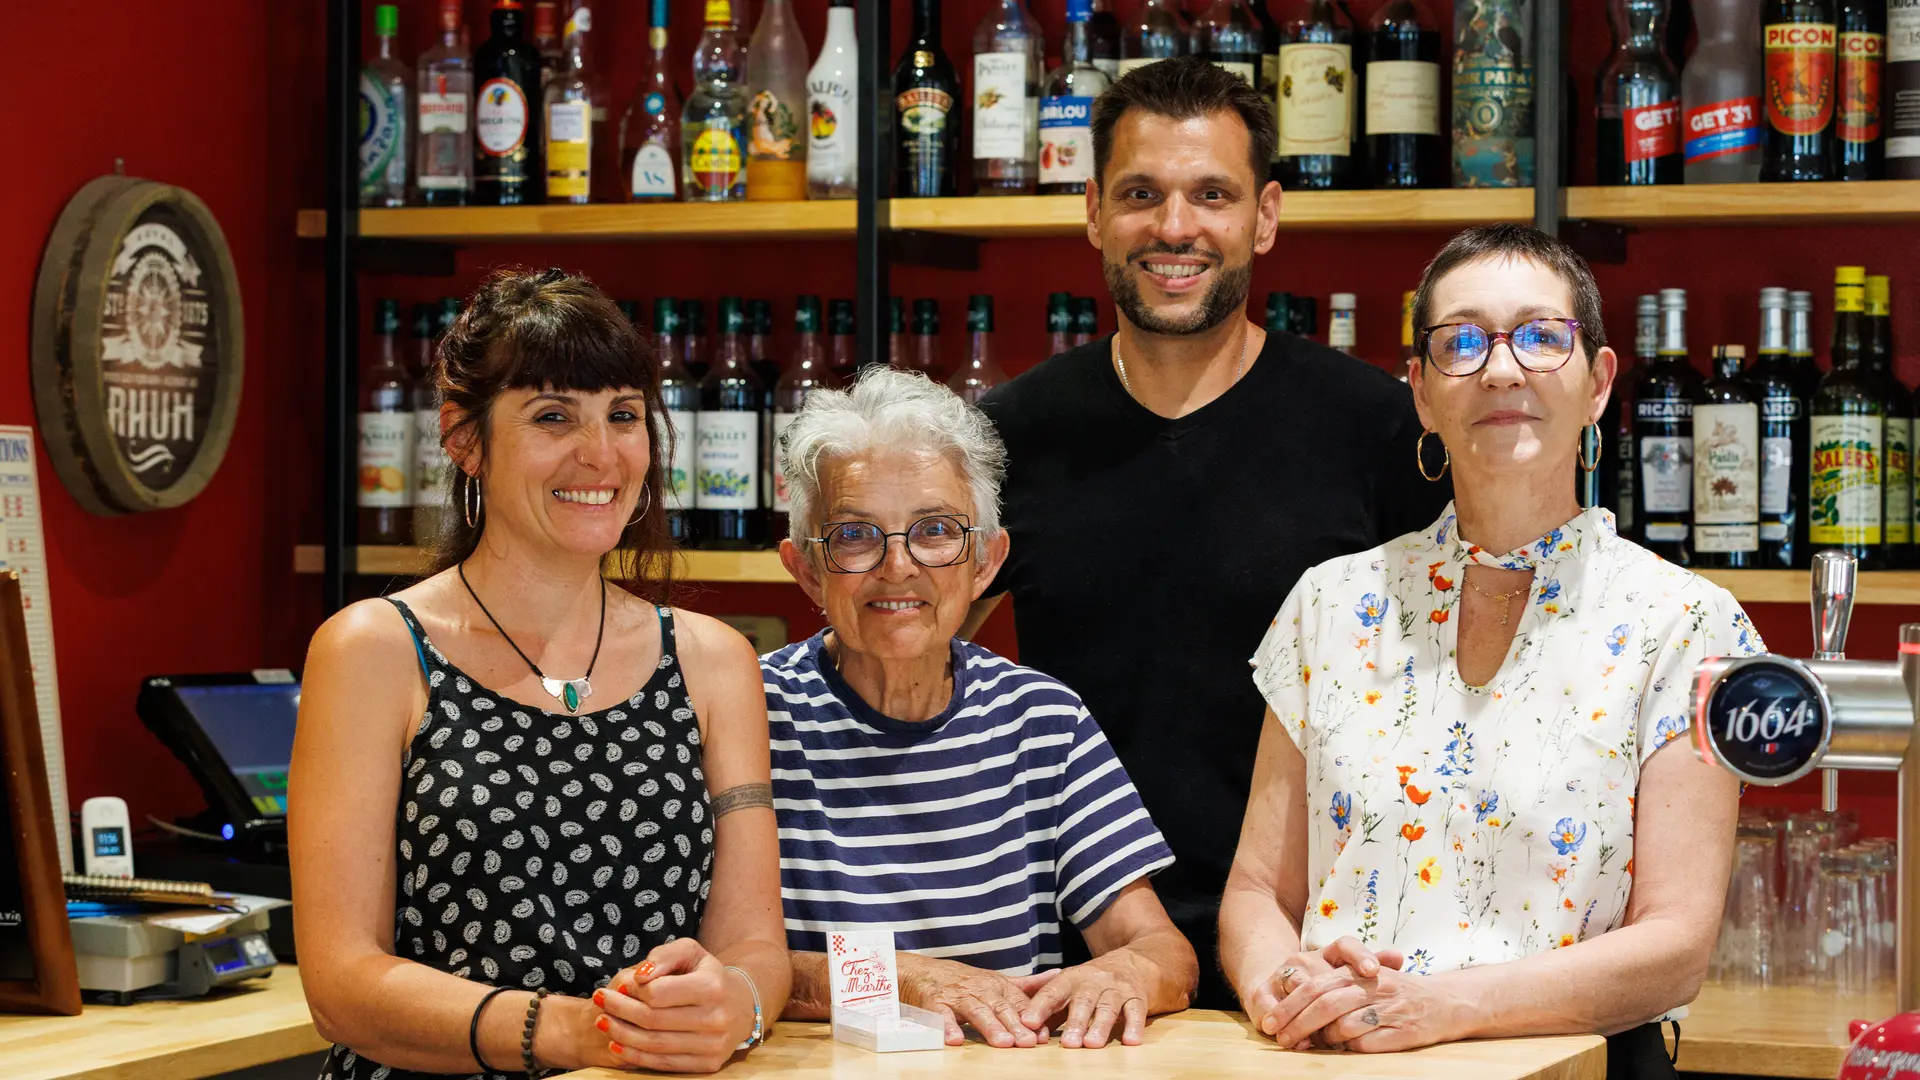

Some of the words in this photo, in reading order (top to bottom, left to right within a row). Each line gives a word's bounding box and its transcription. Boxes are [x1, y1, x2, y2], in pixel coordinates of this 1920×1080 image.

[1768, 29, 1833, 45] PICON
[1842, 38, 1878, 53] ICO
[1634, 108, 1674, 131] GET
[1690, 108, 1729, 132] GET
[1730, 104, 1753, 124] 31
[1763, 403, 1796, 415] ARD
[1814, 449, 1874, 473] SALERS
[1726, 697, 1813, 742] 1664
[841, 960, 875, 984] Chez
[841, 976, 892, 993] Marthe
